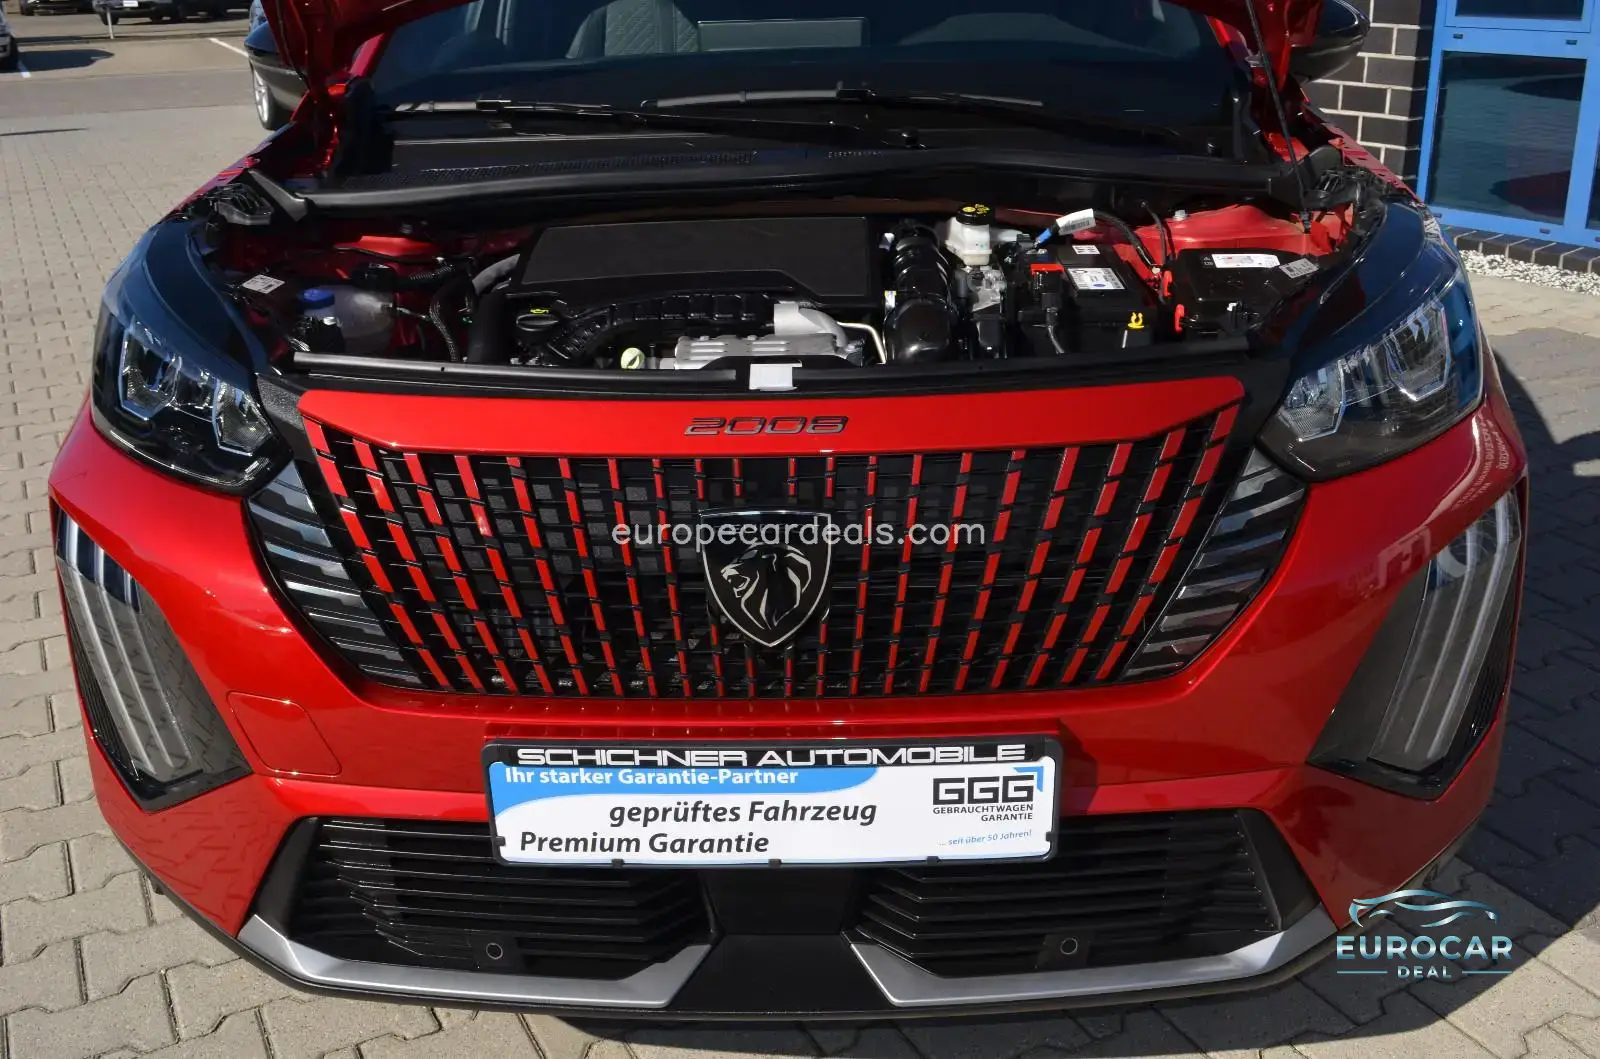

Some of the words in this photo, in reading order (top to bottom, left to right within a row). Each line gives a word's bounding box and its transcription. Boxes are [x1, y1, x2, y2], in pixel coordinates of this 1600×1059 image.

[684, 415, 849, 436] 2008
[516, 748, 748, 767] SCHICHNER
[755, 744, 1026, 767] AUTOMOBILE
[504, 767, 535, 784] Ihr
[539, 767, 613, 785] starker
[618, 767, 799, 785] Garantie-Partner
[932, 774, 1035, 806] GGG
[609, 799, 742, 827] geprüftes
[748, 799, 878, 827] Fahrzeug
[932, 803, 1034, 815] GEBRAUCHTWAGEN
[980, 812, 1034, 823] GARANTIE
[519, 832, 642, 854] Premium
[648, 832, 770, 854] Garantie
[948, 837, 964, 846] seit
[965, 835, 986, 845] über
[987, 833, 999, 842] 50
[999, 828, 1033, 841] Jahren!
